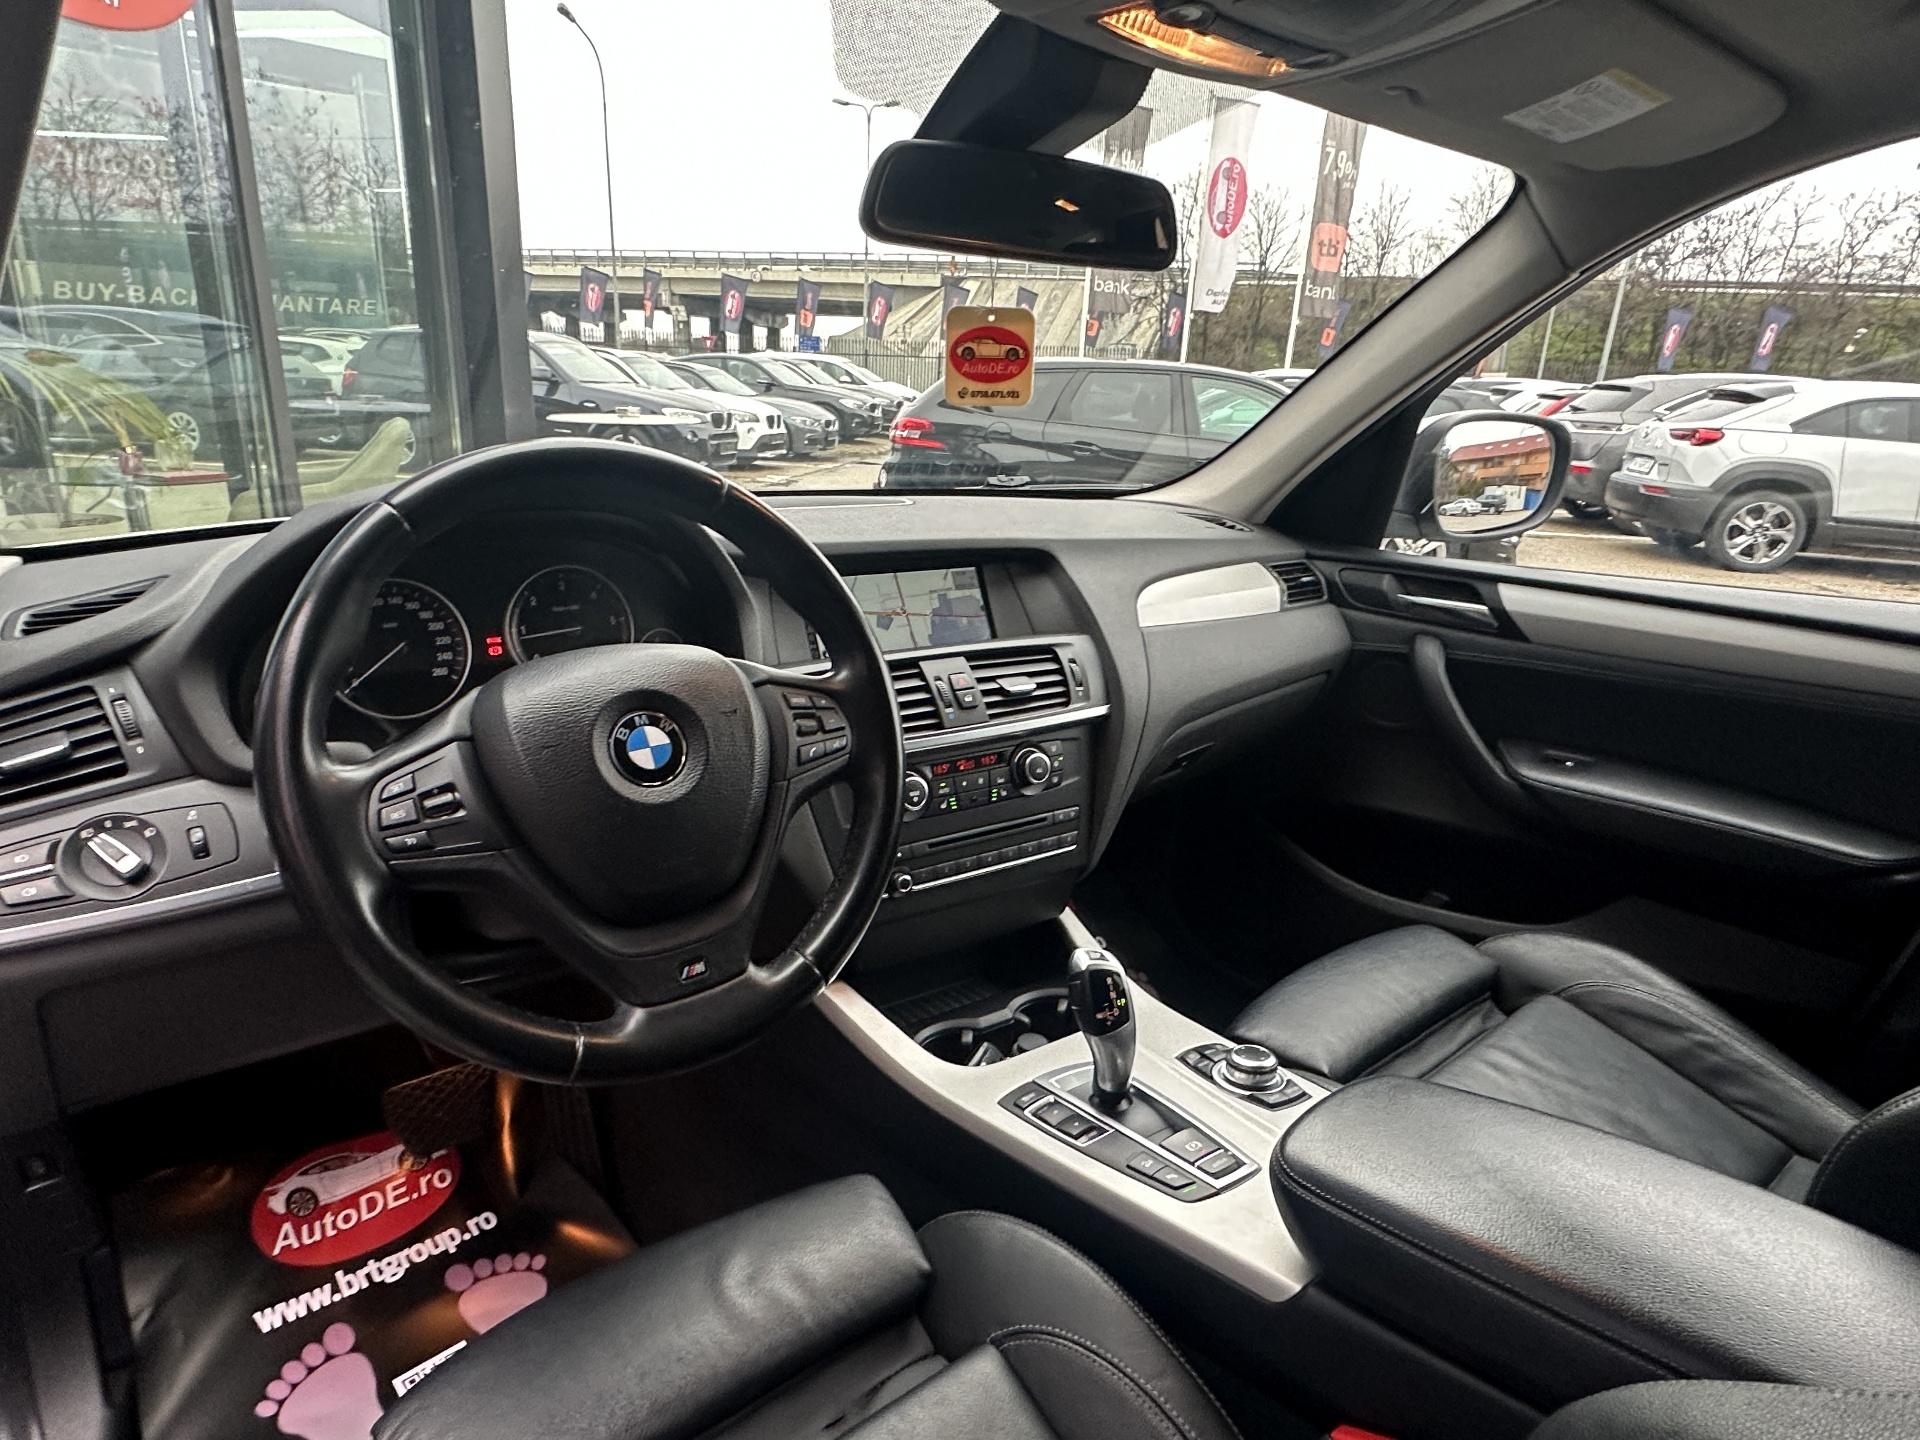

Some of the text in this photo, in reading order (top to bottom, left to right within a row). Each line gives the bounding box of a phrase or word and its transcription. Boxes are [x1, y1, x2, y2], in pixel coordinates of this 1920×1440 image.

[1093, 275, 1130, 295] bank
[961, 361, 1020, 374] AutoDE.ro
[615, 714, 674, 741] BMW
[271, 1167, 453, 1257] AutoDE.ro
[251, 1210, 498, 1334] www.brtgroup.ro
